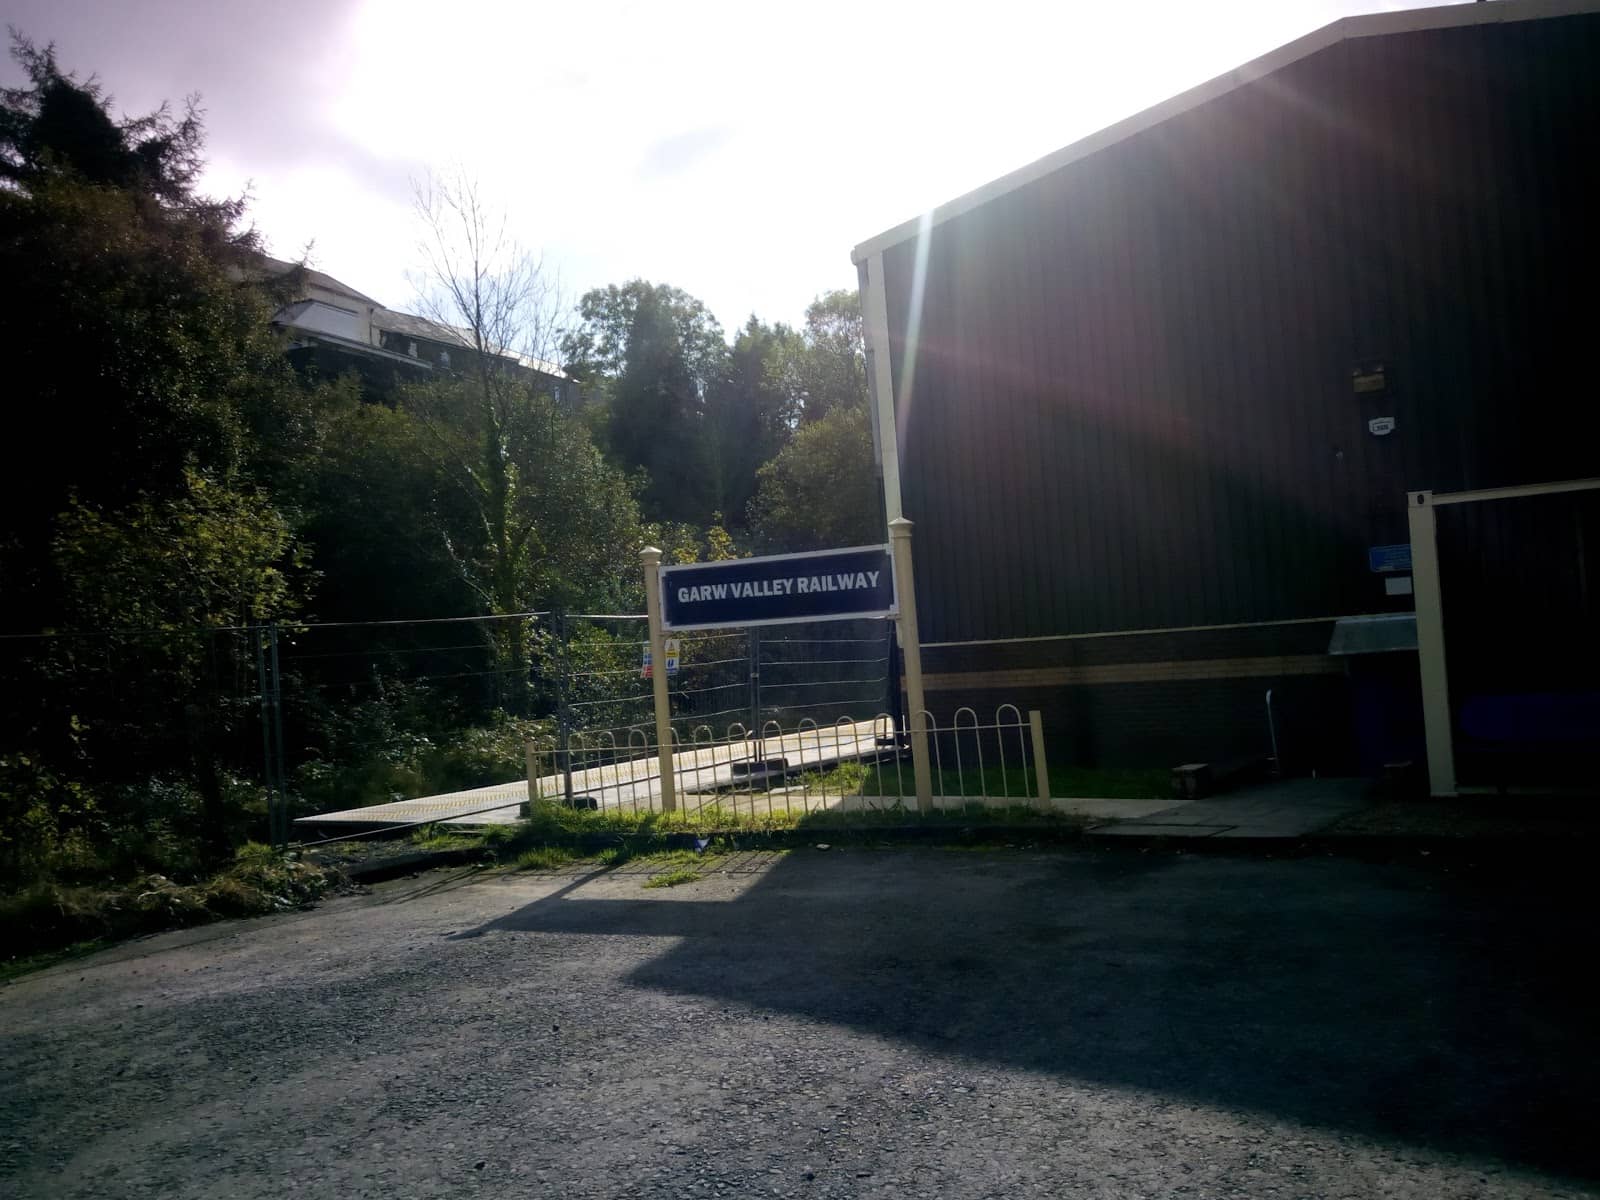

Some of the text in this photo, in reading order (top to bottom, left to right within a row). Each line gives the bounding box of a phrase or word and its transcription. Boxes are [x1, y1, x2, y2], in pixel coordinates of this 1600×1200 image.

[677, 571, 880, 603] GARW VALLEY RAILWAY
